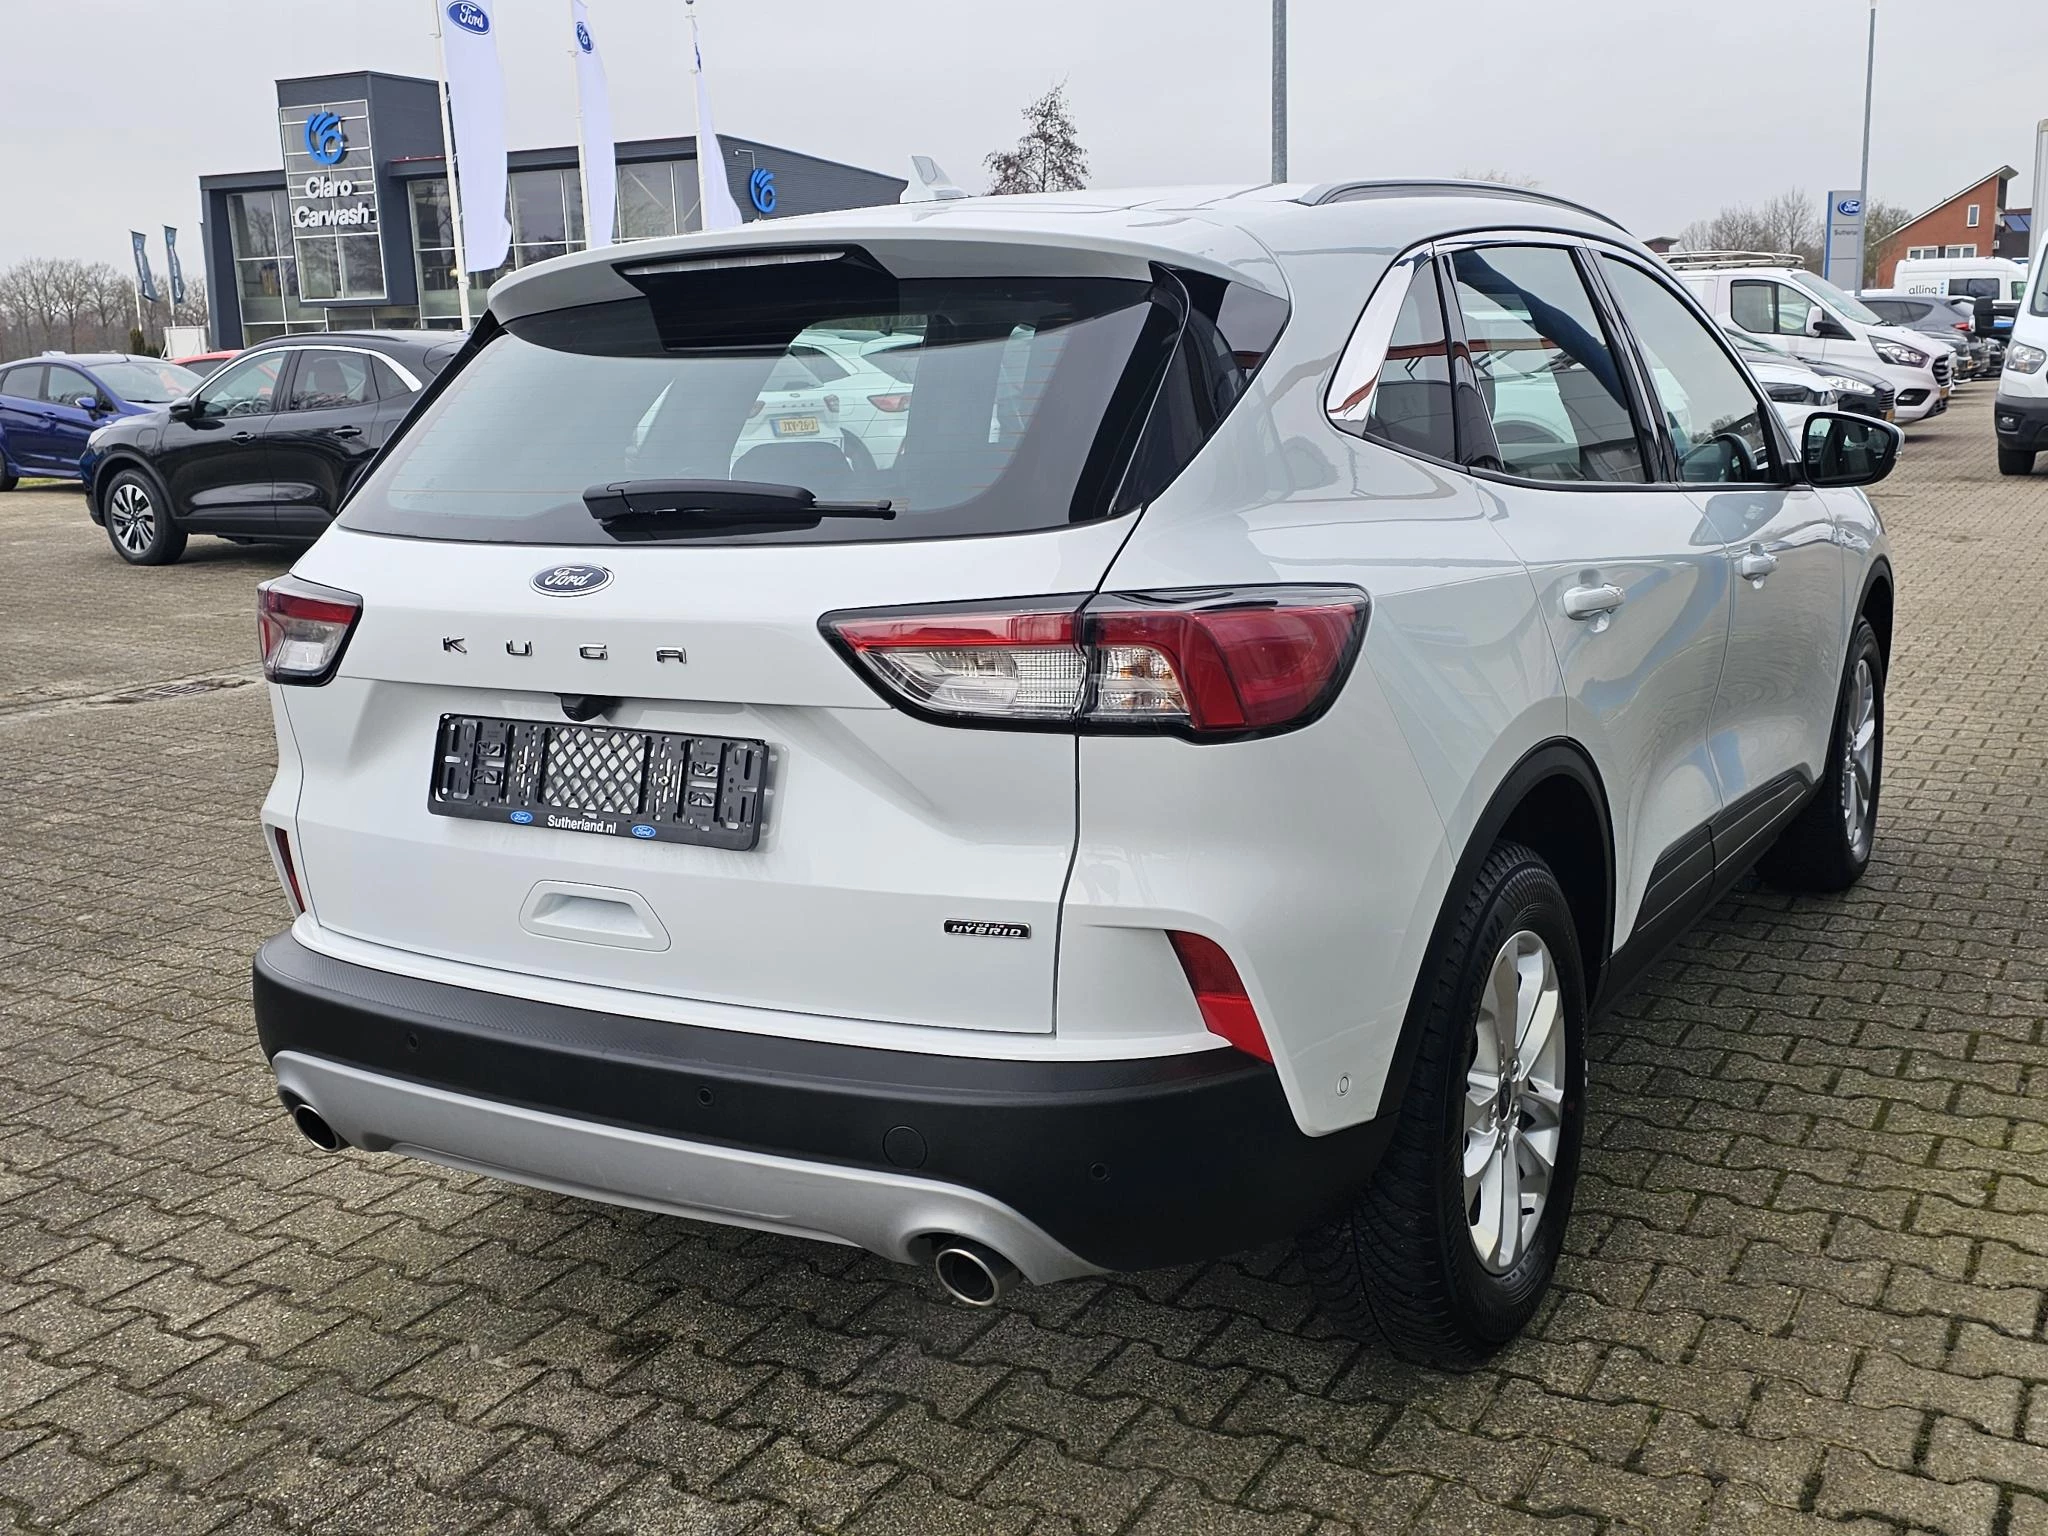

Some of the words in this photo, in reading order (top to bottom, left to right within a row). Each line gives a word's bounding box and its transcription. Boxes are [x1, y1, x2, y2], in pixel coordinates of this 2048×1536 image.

[459, 3, 484, 28] Ford
[305, 176, 352, 198] Claro
[294, 202, 369, 228] Carwash
[544, 566, 589, 587] Ford
[547, 814, 617, 834] Sutherland.nl
[951, 924, 1022, 936] HYBRID
